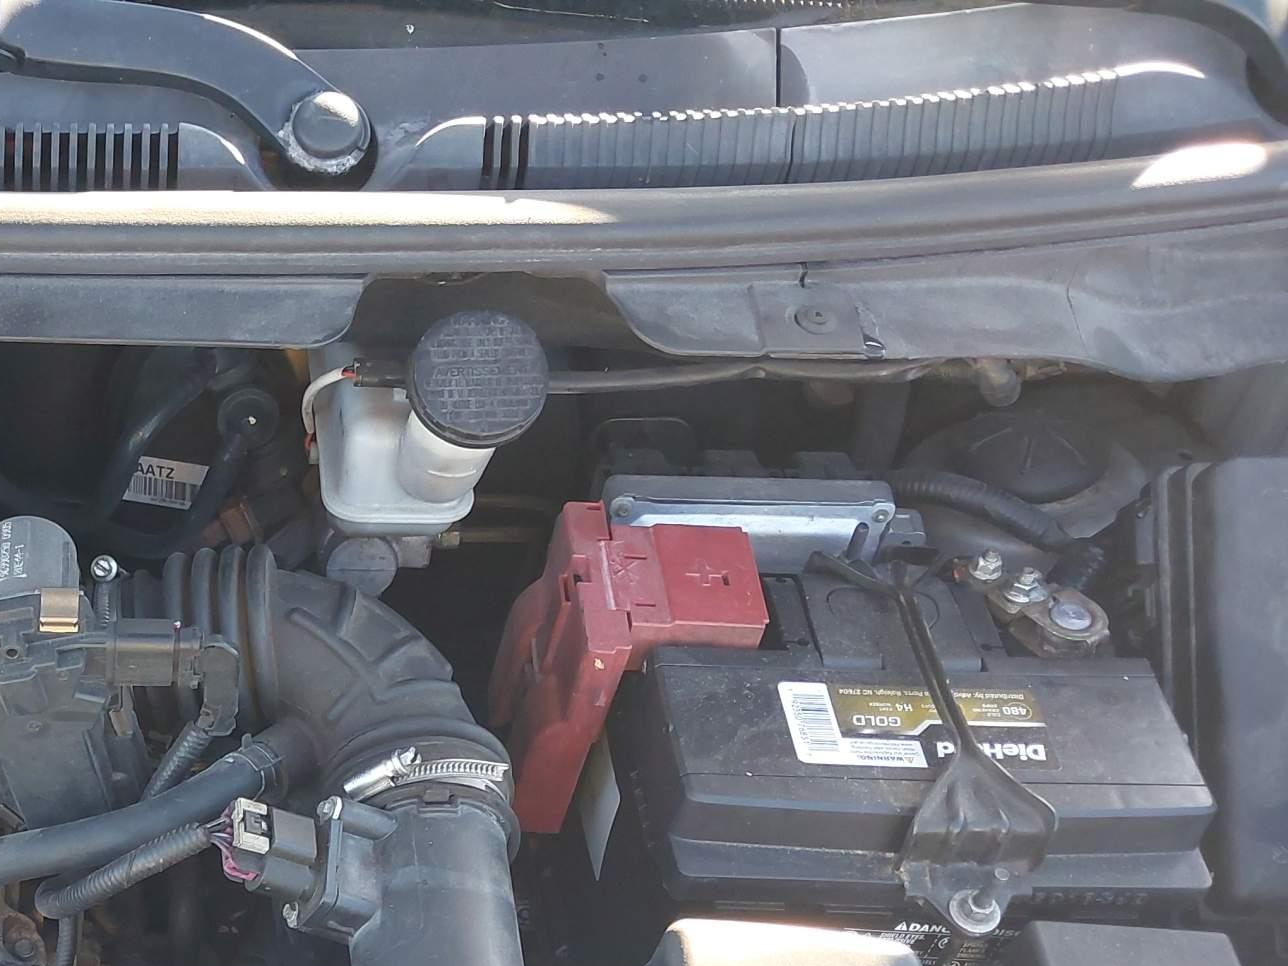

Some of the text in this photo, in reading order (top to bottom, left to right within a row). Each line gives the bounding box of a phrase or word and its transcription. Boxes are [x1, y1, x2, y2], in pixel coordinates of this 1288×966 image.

[895, 703, 913, 712] H4
[1002, 705, 1027, 716] 480
[853, 714, 901, 727] GOLD
[936, 741, 1047, 761] DieHd
